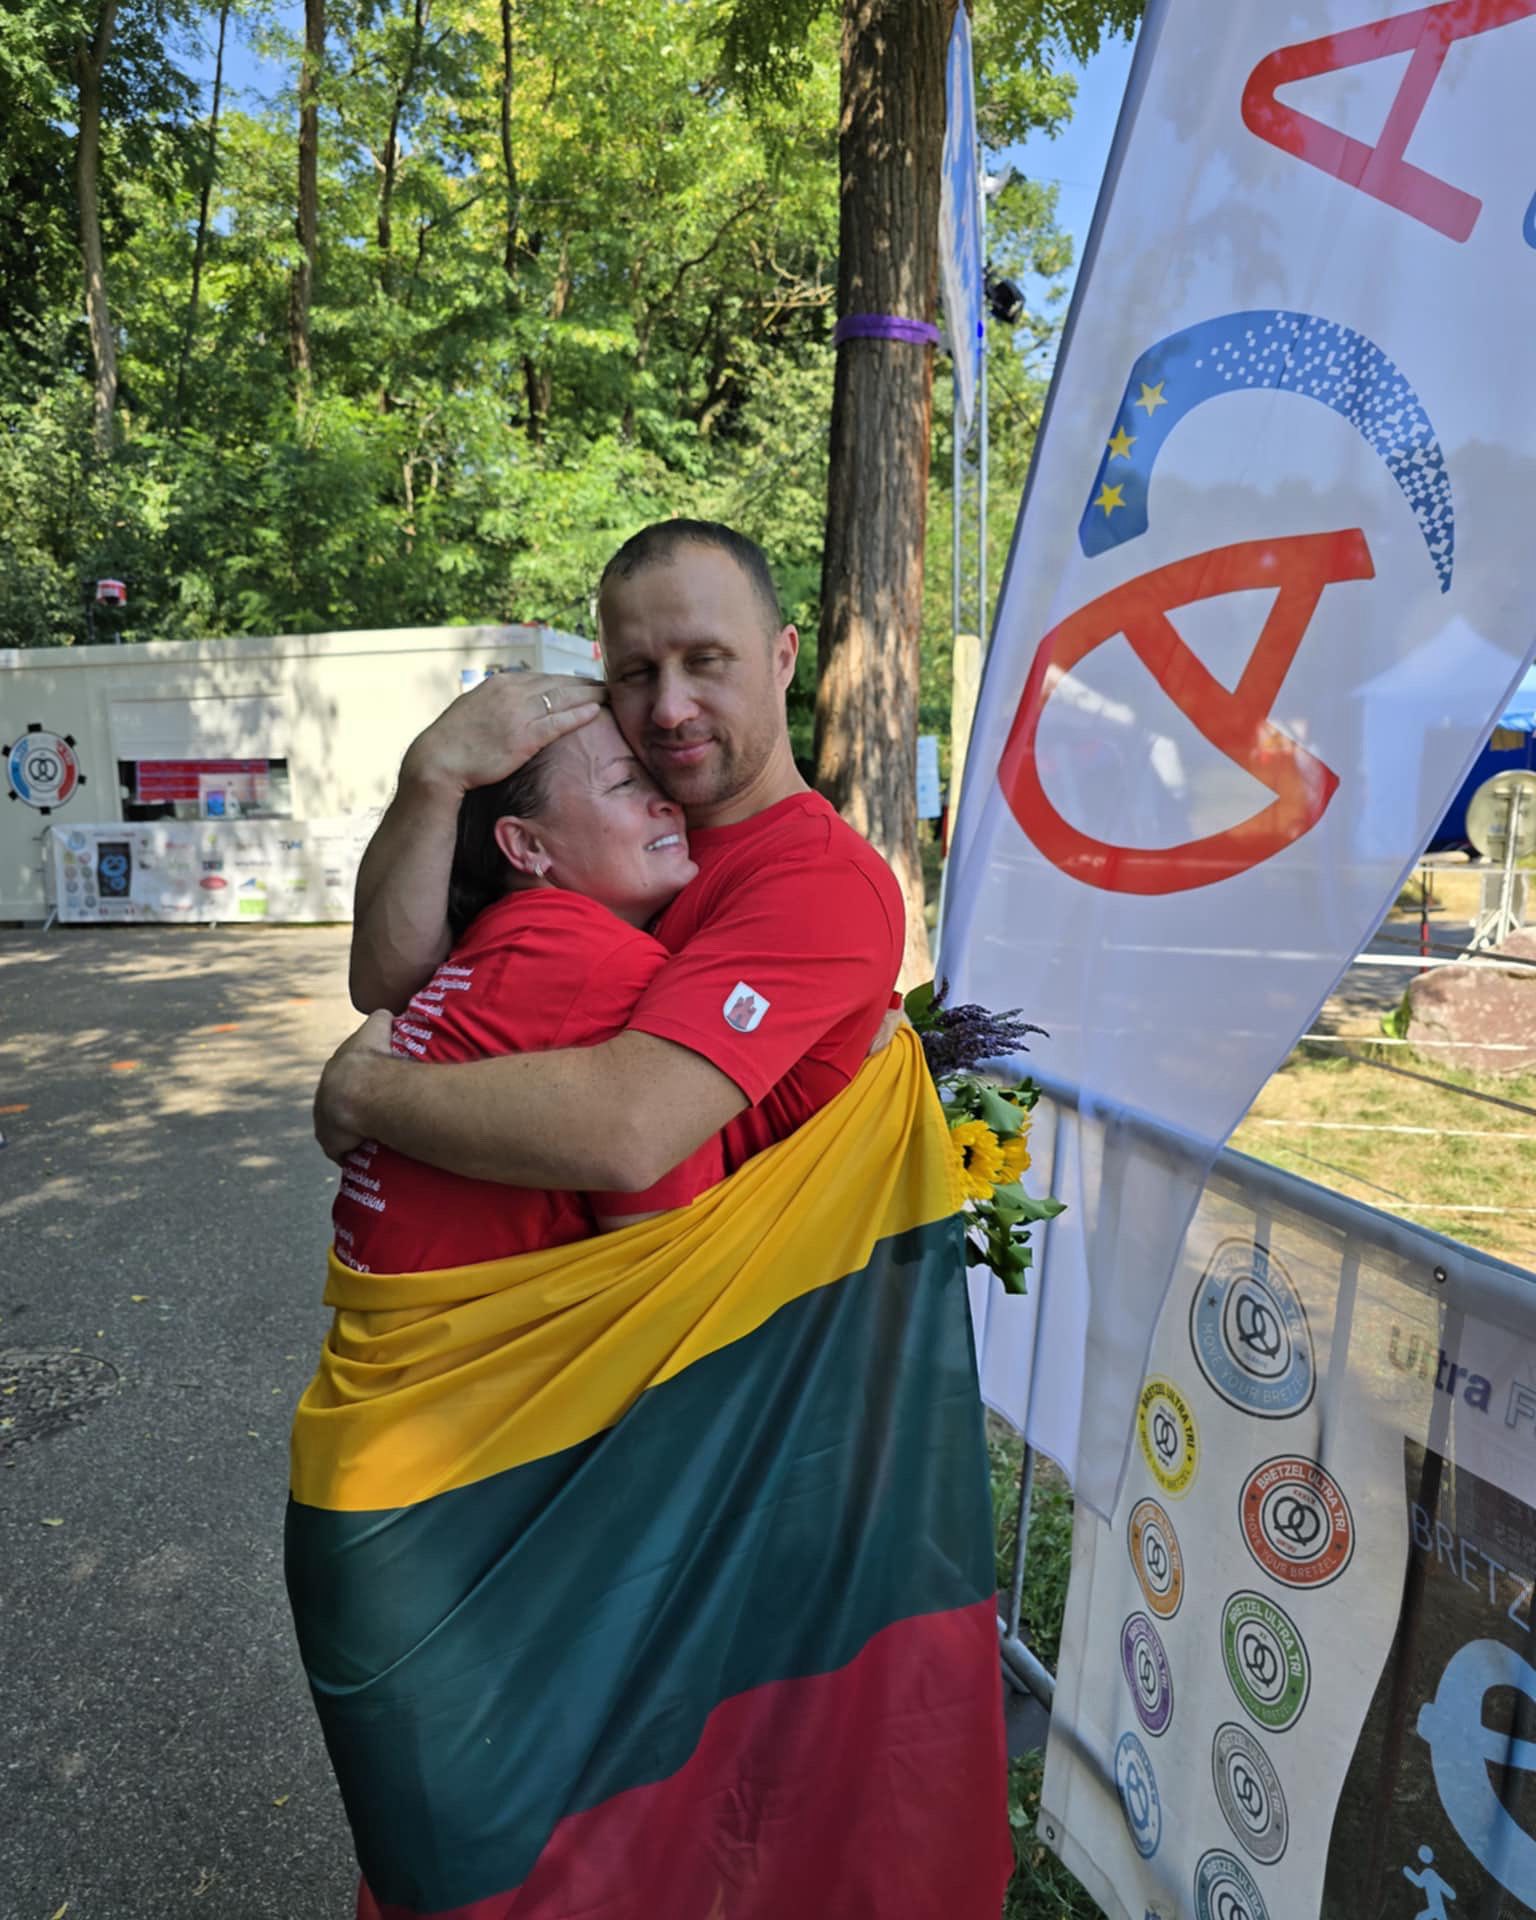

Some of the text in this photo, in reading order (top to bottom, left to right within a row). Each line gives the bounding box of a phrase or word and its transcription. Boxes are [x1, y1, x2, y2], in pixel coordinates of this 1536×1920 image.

[1255, 1463, 1347, 1533] BRETZEL ULTRA TRI
[1290, 1556, 1337, 1578] BRETZEL
[1263, 1607, 1295, 1650] ULTRA
[1288, 1651, 1303, 1678] TRI
